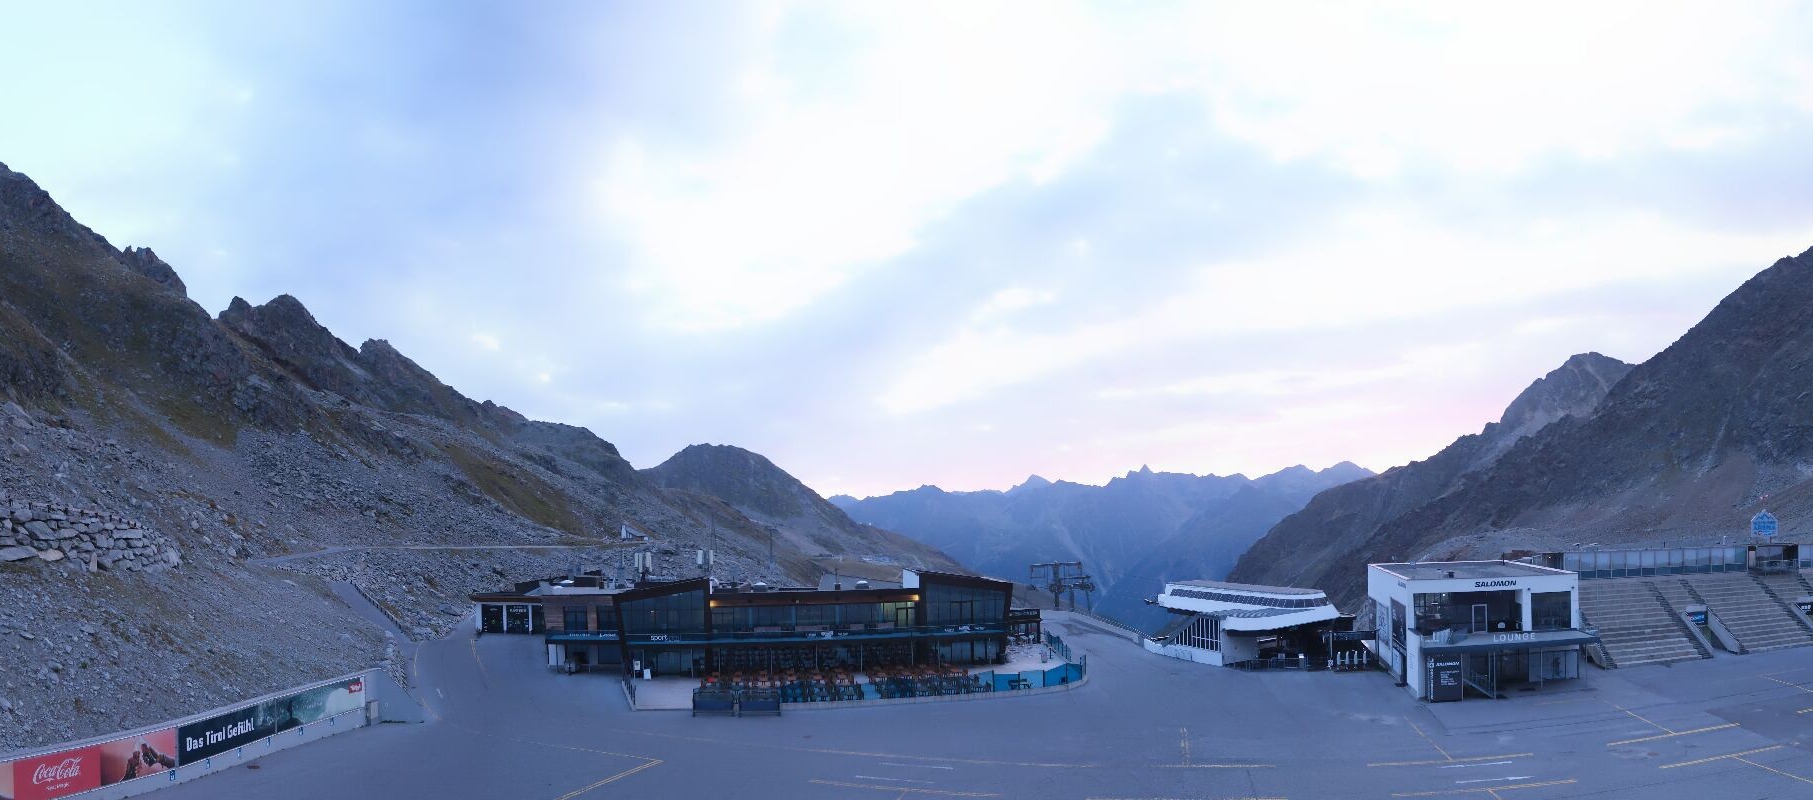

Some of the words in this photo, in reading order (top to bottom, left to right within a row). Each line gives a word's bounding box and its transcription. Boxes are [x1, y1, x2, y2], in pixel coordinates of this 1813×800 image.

[1474, 580, 1517, 588] SALOMON
[1493, 632, 1536, 643] LOUNGE
[186, 736, 204, 752] Das
[205, 726, 226, 746] Tirol
[227, 717, 255, 739] Gefühl
